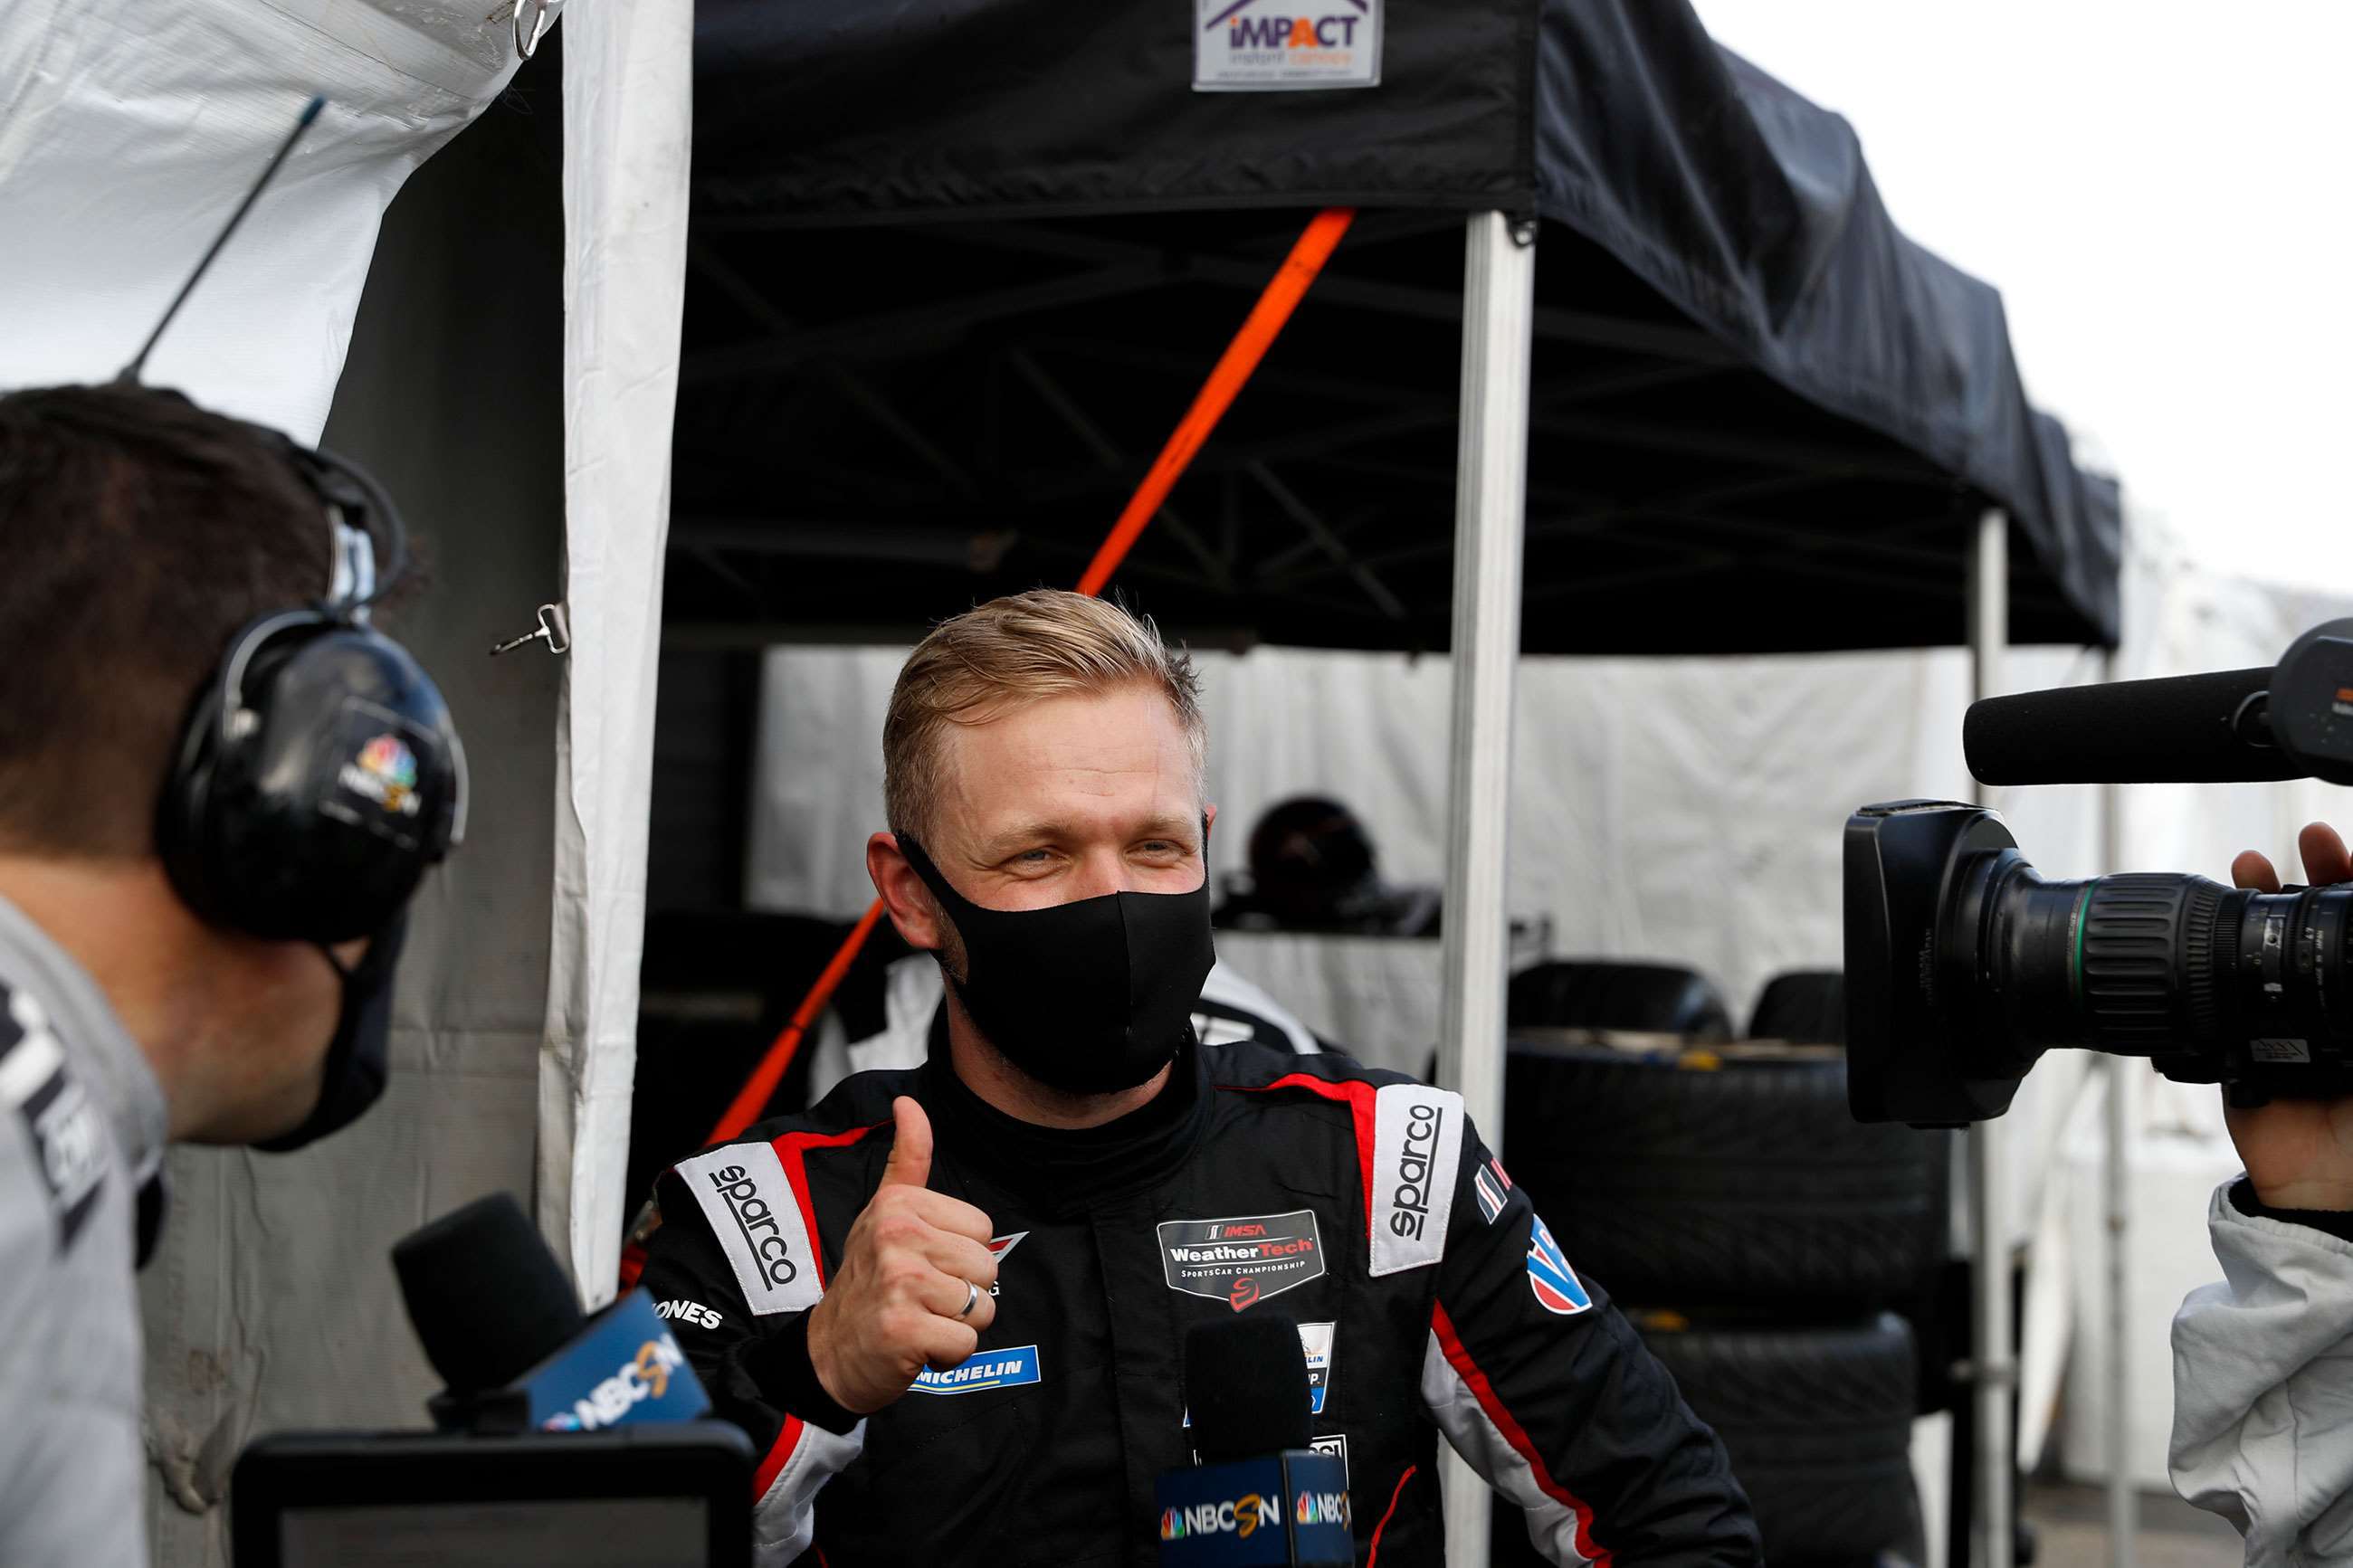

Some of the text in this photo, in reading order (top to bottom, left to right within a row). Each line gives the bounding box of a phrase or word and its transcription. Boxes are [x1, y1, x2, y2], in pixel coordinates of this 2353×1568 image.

[1390, 1105, 1434, 1238] sparco
[717, 1165, 797, 1285] sparco
[1224, 1224, 1267, 1238] IMSA
[1170, 1238, 1315, 1262] WeatherTech
[652, 1299, 723, 1330] ONES
[1185, 1494, 1281, 1539] NBCSN
